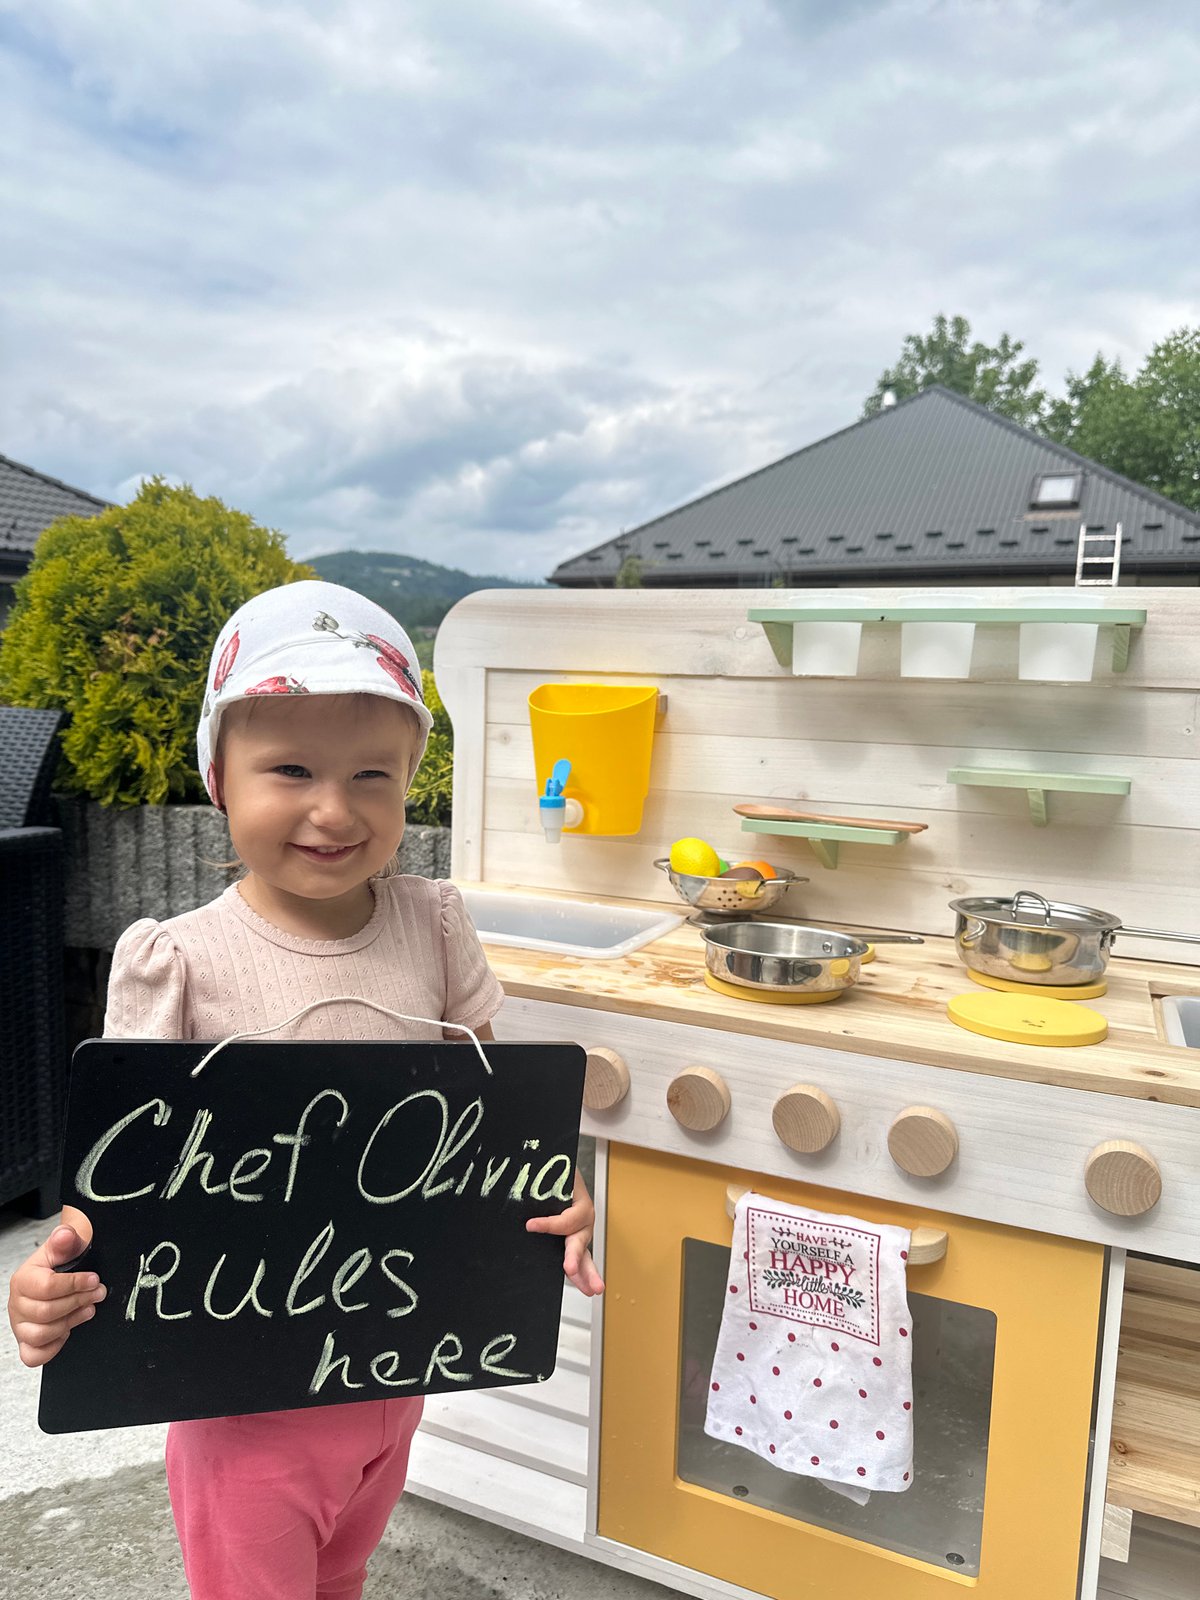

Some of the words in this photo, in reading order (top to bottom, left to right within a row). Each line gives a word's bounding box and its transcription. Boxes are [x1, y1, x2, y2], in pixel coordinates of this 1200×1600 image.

[74, 1089, 349, 1203] Chef
[357, 1089, 573, 1204] Olivia
[771, 1237, 841, 1260] YOURSELF
[844, 1253, 854, 1265] A
[796, 1232, 828, 1246] HAVE
[125, 1220, 419, 1320] Rules
[769, 1250, 856, 1287] HAPPY
[800, 1275, 829, 1294] little
[783, 1287, 846, 1318] HOME
